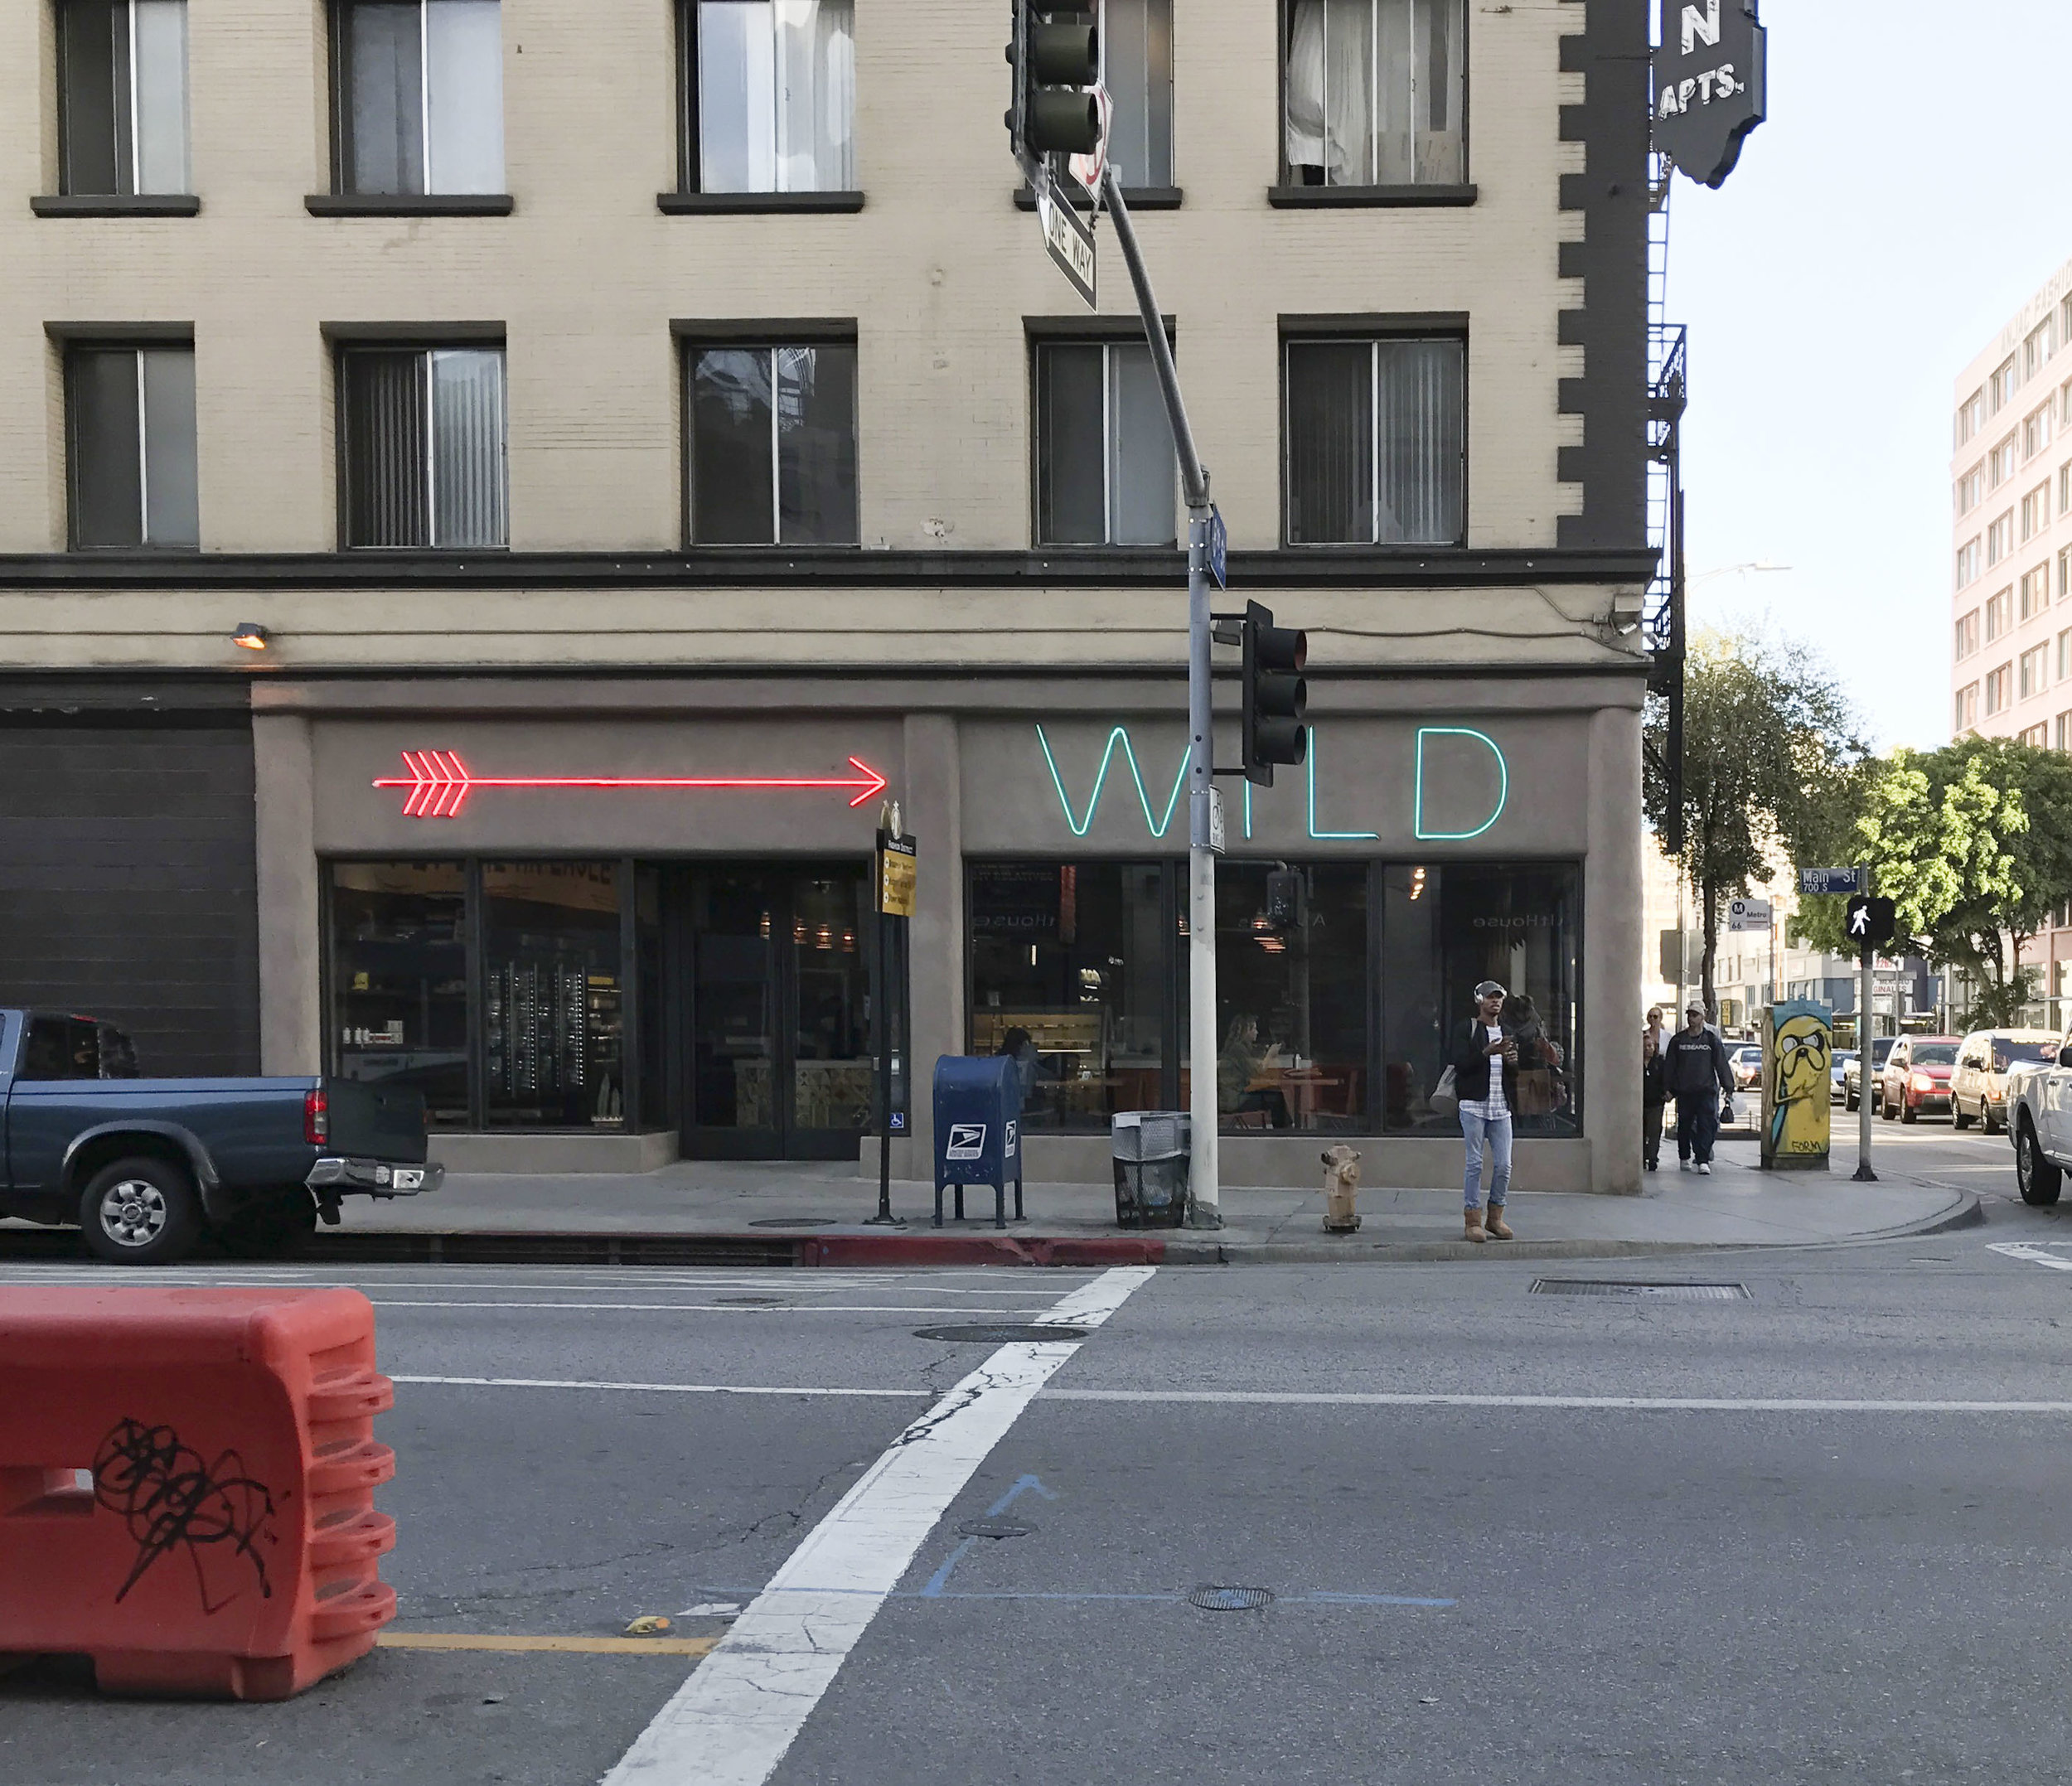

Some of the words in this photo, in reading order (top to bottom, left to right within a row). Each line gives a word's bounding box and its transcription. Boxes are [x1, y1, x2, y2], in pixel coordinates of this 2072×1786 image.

[1681, 0, 1721, 55] N
[1658, 63, 1745, 121] APTS.
[1048, 202, 1067, 254] ONE
[1072, 235, 1092, 283] WAY
[1034, 724, 1508, 841] WILD
[1803, 871, 1829, 883] Main
[1842, 871, 1856, 883] St
[1803, 883, 1819, 892] 700
[1822, 883, 1828, 892] S
[1791, 1140, 1823, 1152] FORM
